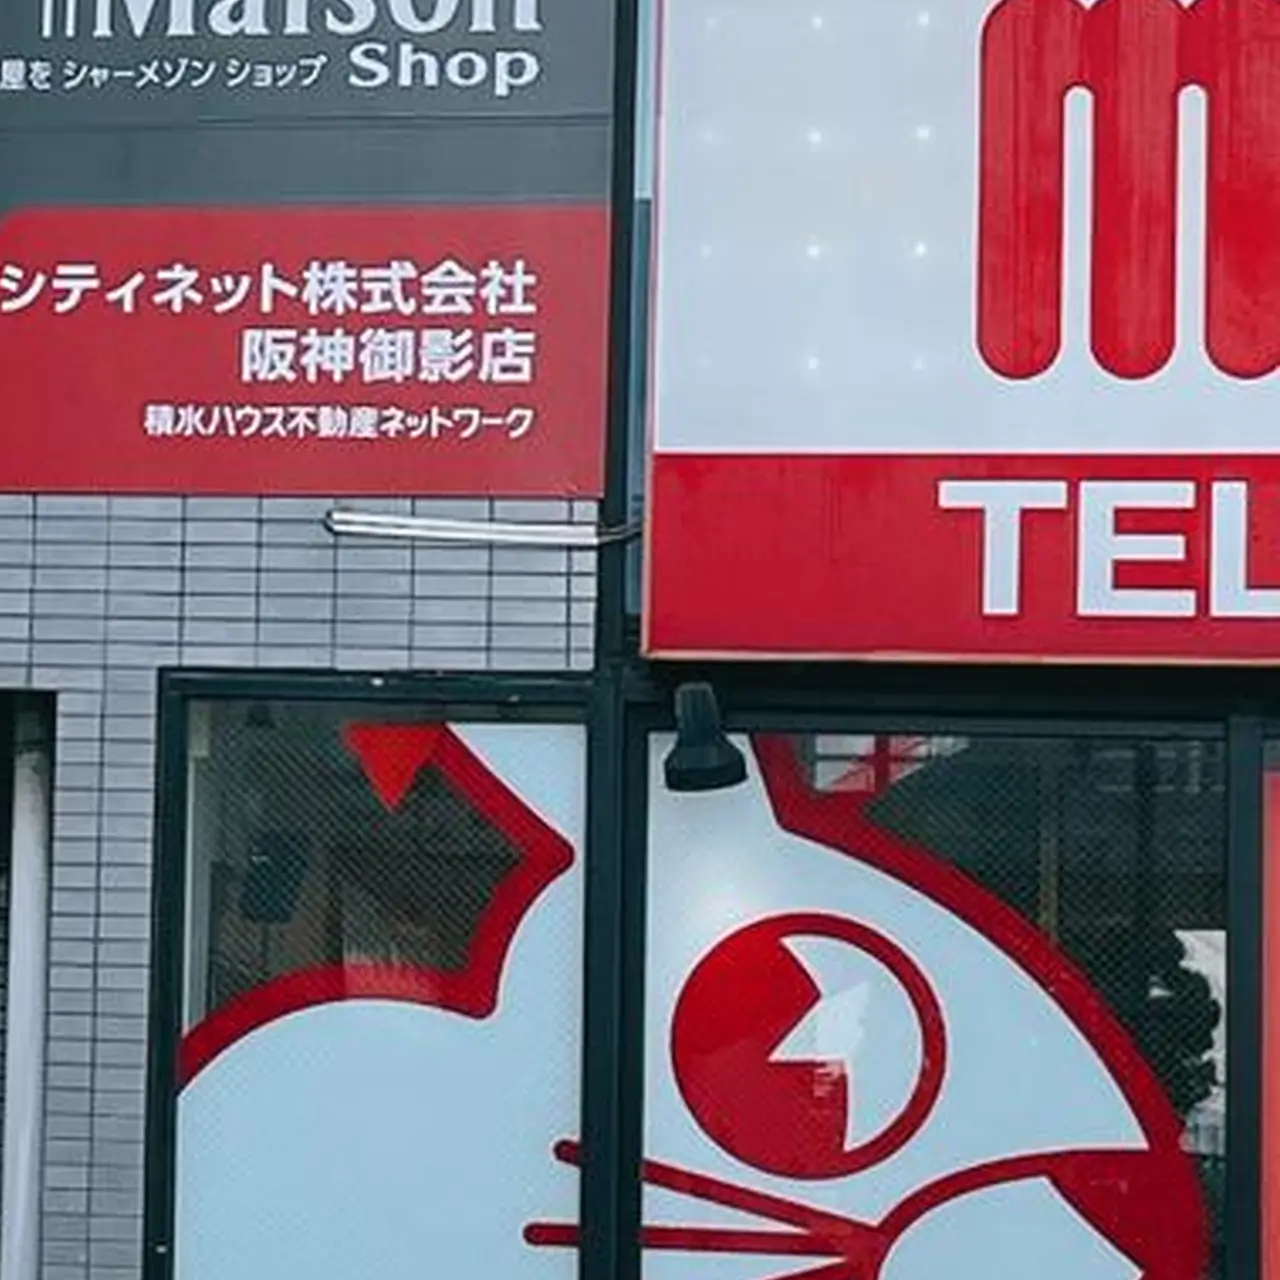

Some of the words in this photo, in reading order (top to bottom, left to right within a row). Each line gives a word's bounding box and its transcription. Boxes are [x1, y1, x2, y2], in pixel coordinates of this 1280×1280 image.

[62, 58, 215, 90] シャーメゾン
[225, 57, 327, 89] ショップ
[346, 41, 543, 97] Shop
[240, 326, 535, 384] 阪神御影店
[144, 404, 534, 440] 積水ハウス不動産ネットワーク
[938, 478, 1280, 618] TEL
